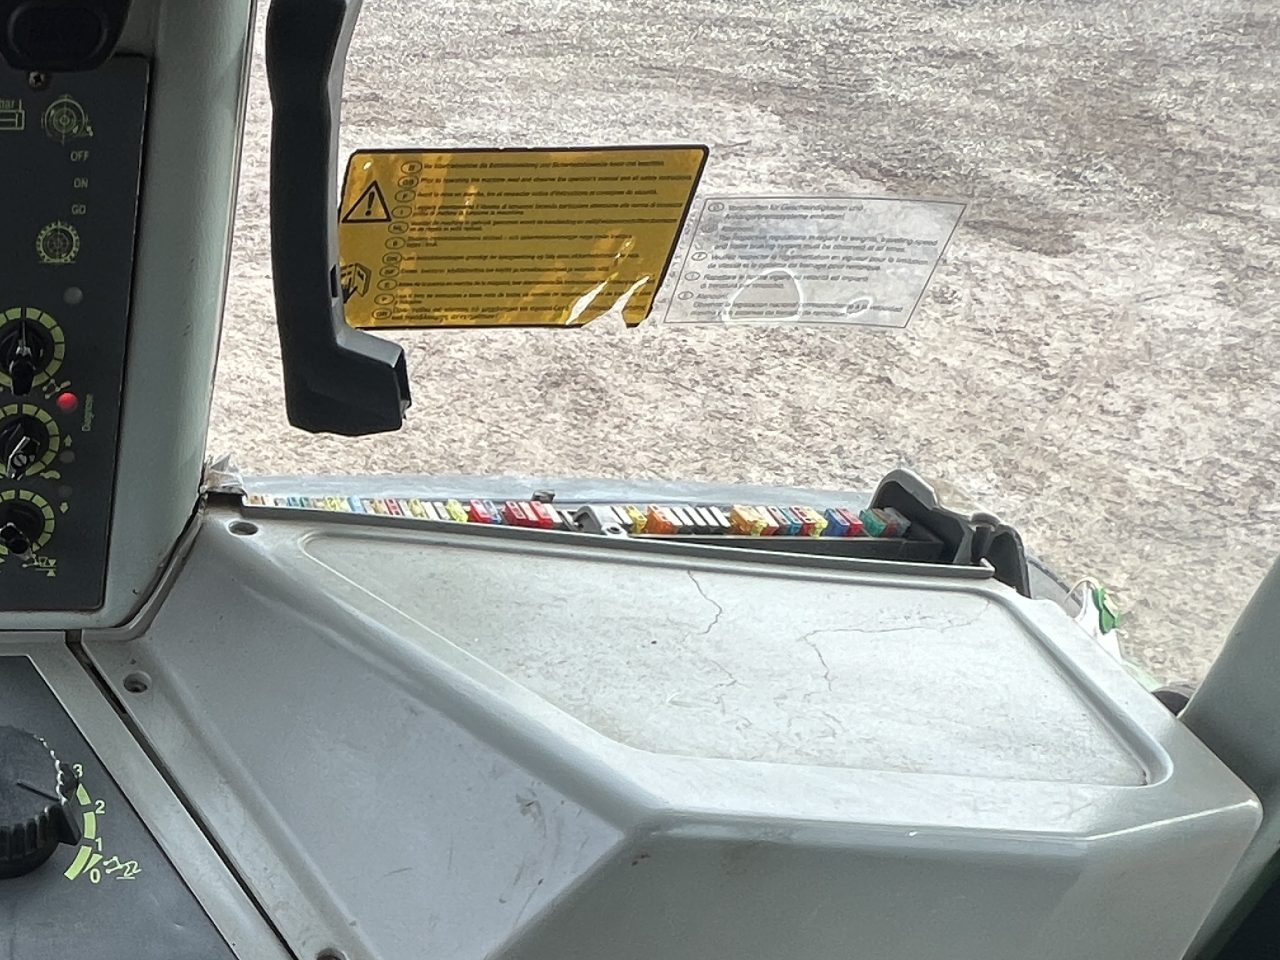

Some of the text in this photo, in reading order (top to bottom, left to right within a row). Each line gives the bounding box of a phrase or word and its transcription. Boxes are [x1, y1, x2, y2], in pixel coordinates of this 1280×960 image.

[70, 150, 89, 162] OFF
[73, 177, 89, 189] ON
[73, 763, 83, 778] 3
[95, 800, 105, 814] 2
[95, 837, 102, 851] 1
[89, 868, 101, 883] 0
